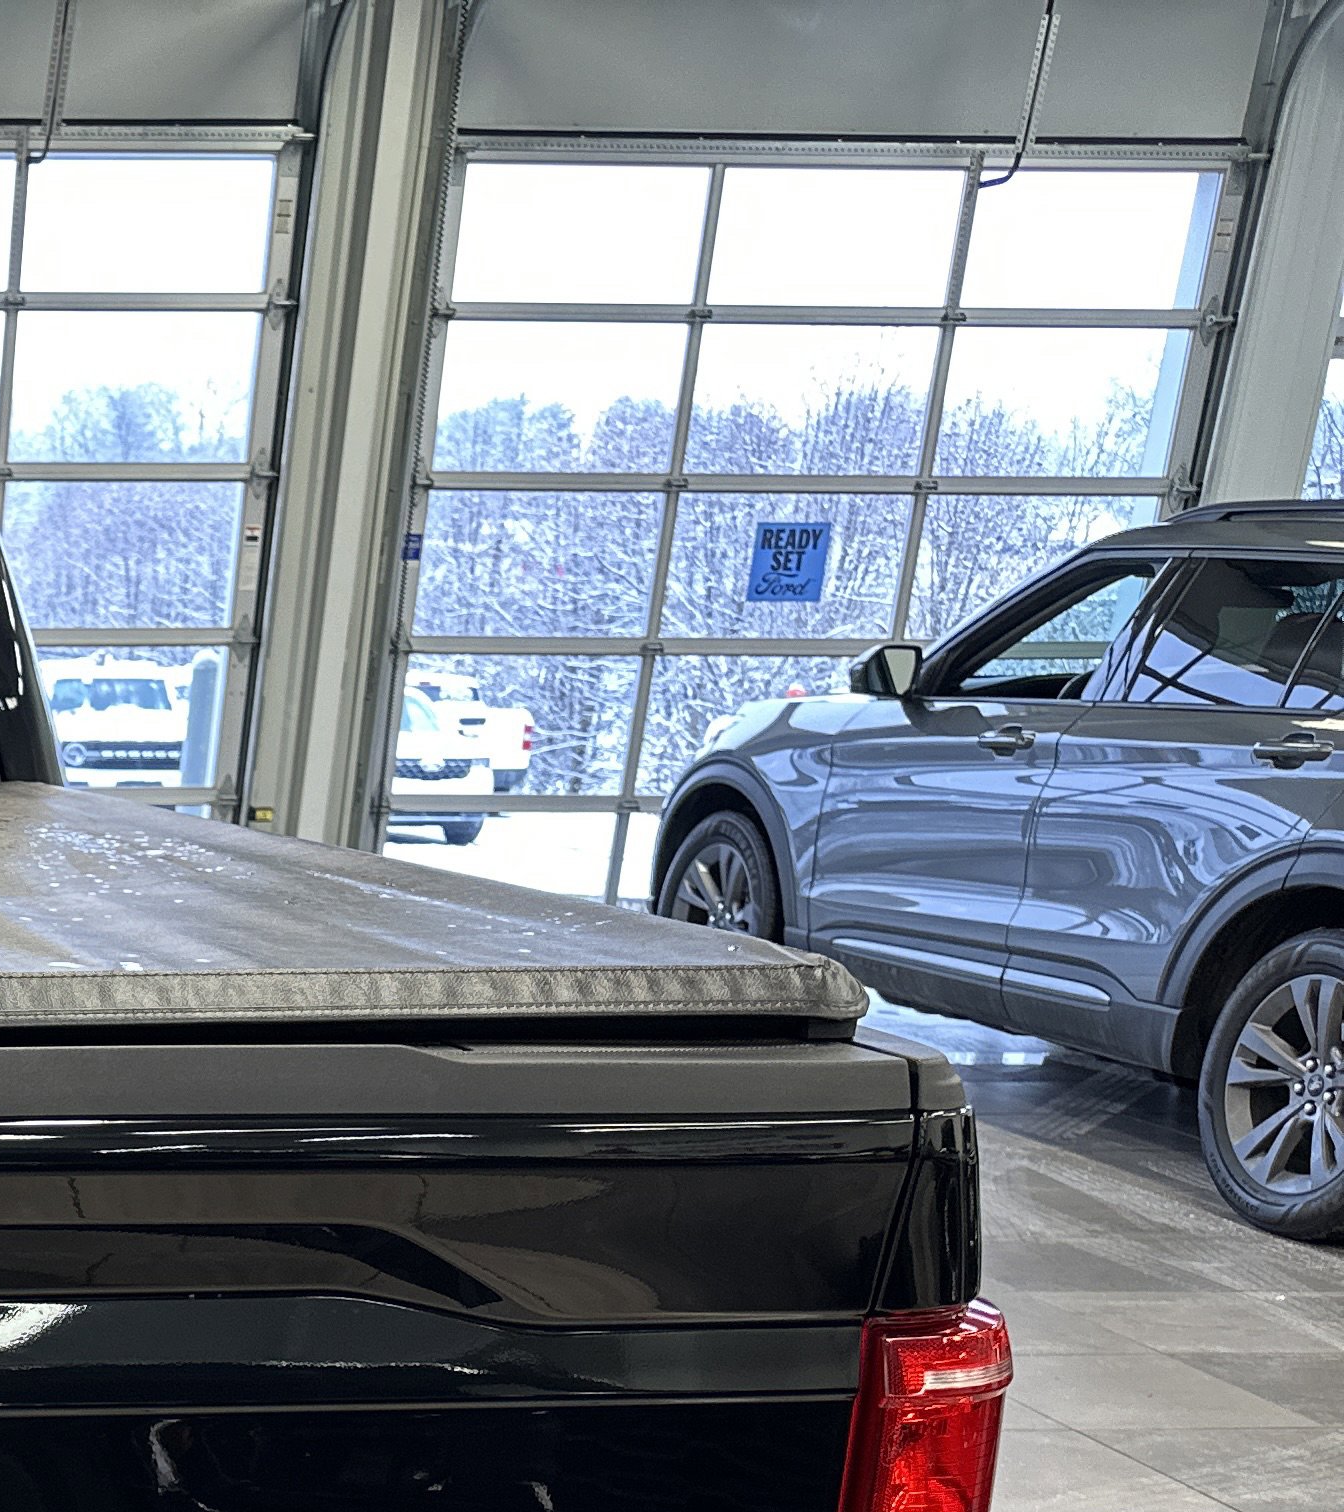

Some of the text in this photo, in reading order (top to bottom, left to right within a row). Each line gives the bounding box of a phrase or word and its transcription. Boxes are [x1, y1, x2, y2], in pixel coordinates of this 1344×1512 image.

[760, 528, 823, 550] READY
[770, 551, 806, 571] SET
[755, 572, 812, 596] Ford
